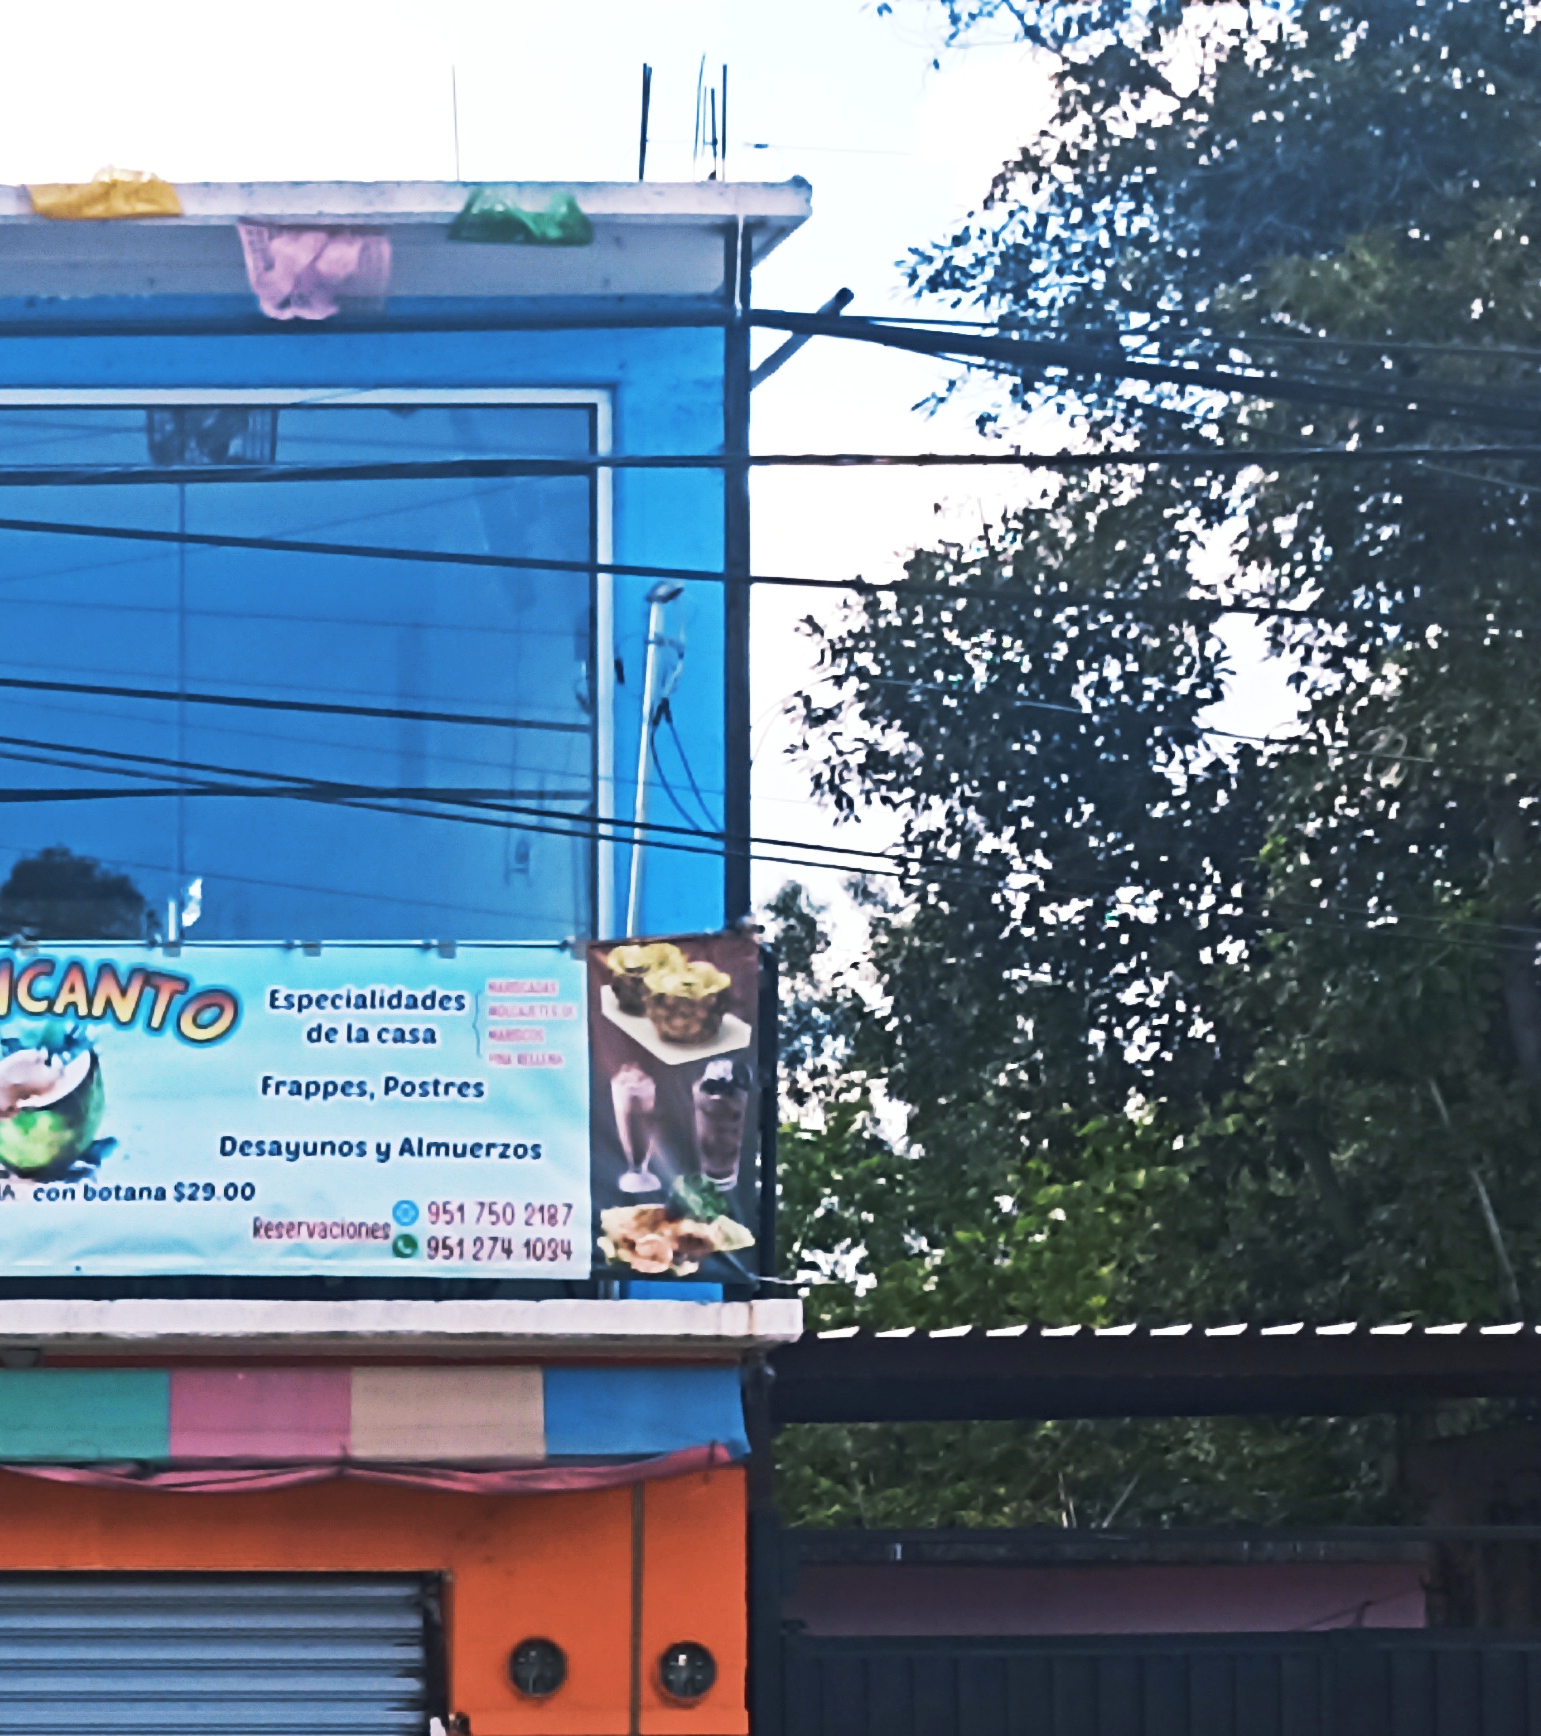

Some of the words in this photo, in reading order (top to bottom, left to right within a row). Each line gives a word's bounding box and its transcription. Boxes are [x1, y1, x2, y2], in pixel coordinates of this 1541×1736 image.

[269, 988, 466, 1013] Especialidades
[306, 1023, 338, 1044] de
[346, 1024, 370, 1044] la
[377, 1026, 437, 1044] casa
[262, 1075, 375, 1101] Frappes,
[384, 1076, 485, 1098] Postres
[220, 1135, 367, 1162] Desayunos
[375, 1142, 392, 1163] y
[399, 1137, 542, 1160] Almuerzos
[32, 1186, 76, 1202] con
[83, 1183, 167, 1202] botana
[174, 1181, 256, 1203] $29.00
[427, 1201, 465, 1226] 951
[474, 1201, 515, 1226] 750
[524, 1202, 573, 1227] 2187
[253, 1216, 391, 1240] Reservaciones
[427, 1235, 465, 1260] 951
[472, 1236, 513, 1261] 274
[524, 1237, 573, 1262] 1034
